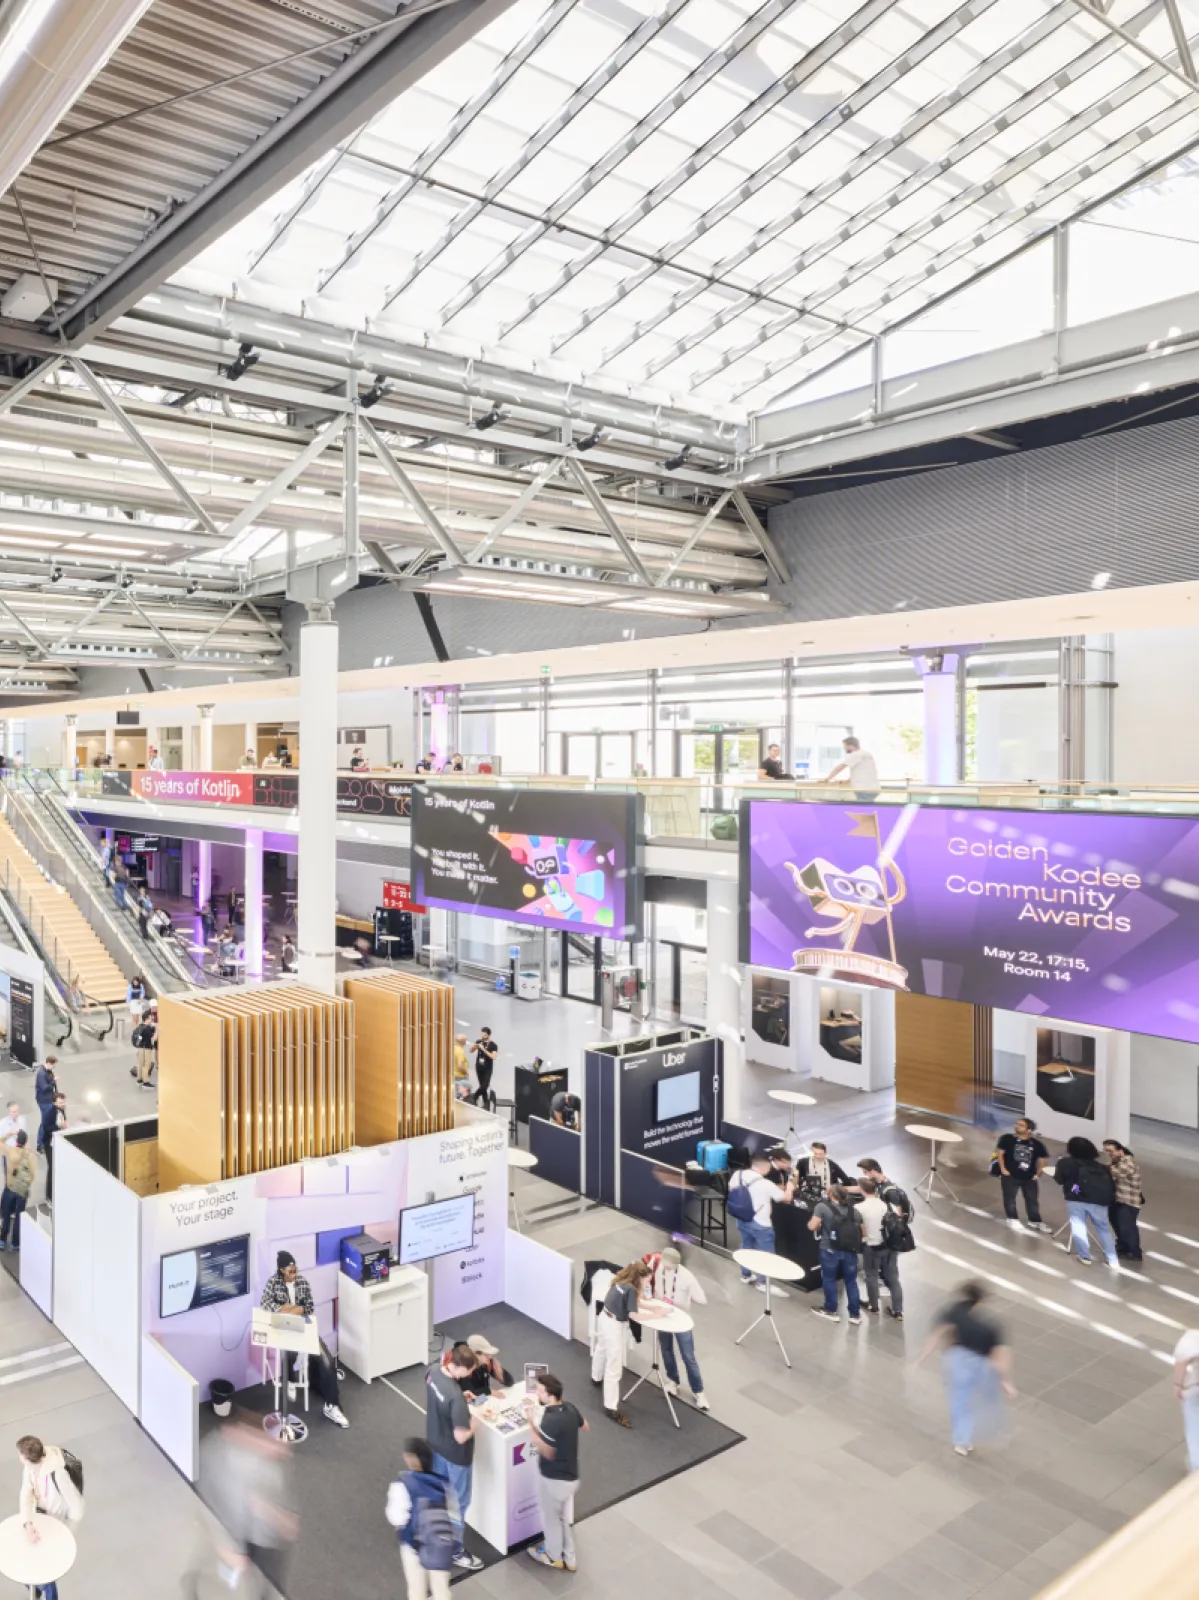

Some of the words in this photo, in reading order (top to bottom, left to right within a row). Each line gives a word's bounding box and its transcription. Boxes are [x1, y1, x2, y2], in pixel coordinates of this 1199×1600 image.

[140, 777, 152, 792] 15
[154, 780, 183, 796] years
[185, 778, 199, 795] of
[201, 778, 240, 798] Kotlin
[470, 799, 494, 810] Kotlin
[432, 848, 445, 857] You
[446, 850, 472, 860] shaped
[948, 837, 1049, 861] Golden
[432, 867, 445, 877] You
[462, 862, 478, 870] with
[1044, 863, 1141, 889] Kodee
[946, 875, 1115, 911] Community
[1018, 902, 1131, 932] Awards
[984, 946, 1016, 962] May
[1046, 955, 1090, 972] 17:15,
[1004, 963, 1050, 979] Room
[1054, 971, 1072, 982] 14
[662, 1052, 686, 1068] Uber
[439, 1137, 474, 1153] Shaping
[475, 1130, 503, 1144] Kotlin's
[468, 1141, 504, 1157] Together
[170, 1201, 197, 1214] Your
[176, 1213, 202, 1227] Your
[204, 1206, 234, 1221] stage
